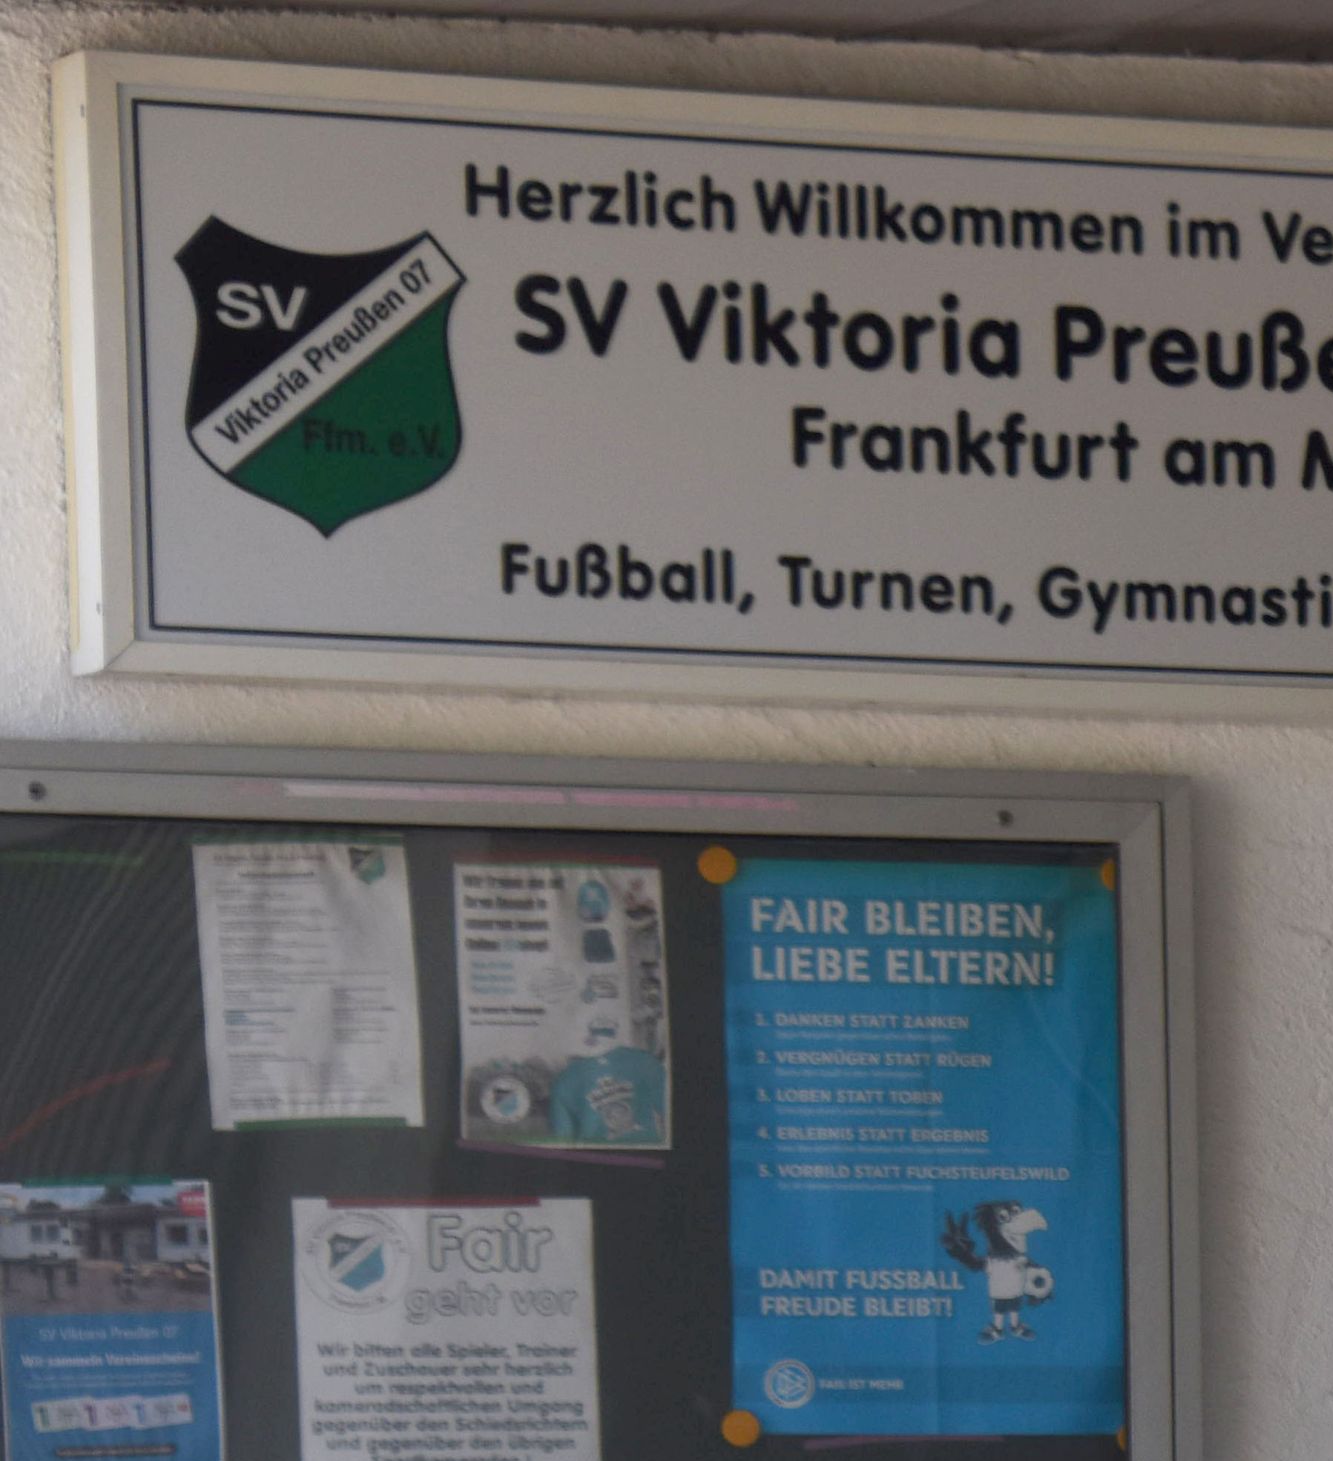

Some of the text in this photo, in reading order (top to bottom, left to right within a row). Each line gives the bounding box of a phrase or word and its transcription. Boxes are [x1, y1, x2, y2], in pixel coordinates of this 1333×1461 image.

[464, 163, 736, 232] Herzlich
[754, 179, 1144, 256] Willkommen
[1167, 202, 1240, 260] im
[214, 281, 309, 331] SV
[514, 273, 628, 358] SV
[657, 280, 1020, 380] Viktoria
[214, 258, 434, 445] Viktoria Preußen 07
[303, 418, 445, 459] Ffm. e.V.
[791, 404, 1139, 483] Frankfurt
[1164, 436, 1275, 488] am
[500, 542, 756, 616] Fußball,
[777, 554, 1014, 626] Turnen,
[750, 898, 1056, 944] FAIR BLEIBEN,
[752, 946, 1056, 987] LIEBE ELTERN!
[775, 1012, 845, 1028] DANKEN
[849, 1013, 898, 1029] STATT
[903, 1014, 970, 1030] ZANKEN
[776, 1048, 880, 1067] VERGNÜGEN
[884, 1051, 932, 1067] STATT
[937, 1050, 992, 1069] RÜGEN
[776, 1089, 832, 1103] LOBEN
[836, 1089, 884, 1104] STATT
[889, 1089, 944, 1105] TOBEN
[777, 1127, 854, 1141] ERLEBNIS
[858, 1128, 905, 1142] STATT
[911, 1127, 989, 1143] ERGEBNIS
[778, 1164, 850, 1179] VORBILD
[854, 1165, 901, 1180] STATT
[906, 1165, 1071, 1181] FUCHSTEUFELSWILD
[427, 1211, 553, 1273] Fair
[760, 1269, 965, 1290] DAMIT FUSSBALL
[405, 1280, 578, 1325] geht vor
[762, 1297, 953, 1318] FREUDE BLEIBT!
[317, 1344, 347, 1357] Wir
[353, 1344, 403, 1358] bitten
[410, 1344, 441, 1358] alle
[516, 1344, 577, 1358] Trainer
[322, 1362, 573, 1377] und Zuschauer sehr herzlich
[354, 1383, 383, 1394] um
[510, 1381, 544, 1394] und
[507, 1401, 584, 1416] Umgang
[312, 1418, 410, 1435] gegenüber
[415, 1419, 449, 1432] den
[326, 1437, 361, 1450] und
[469, 1437, 502, 1450] den
